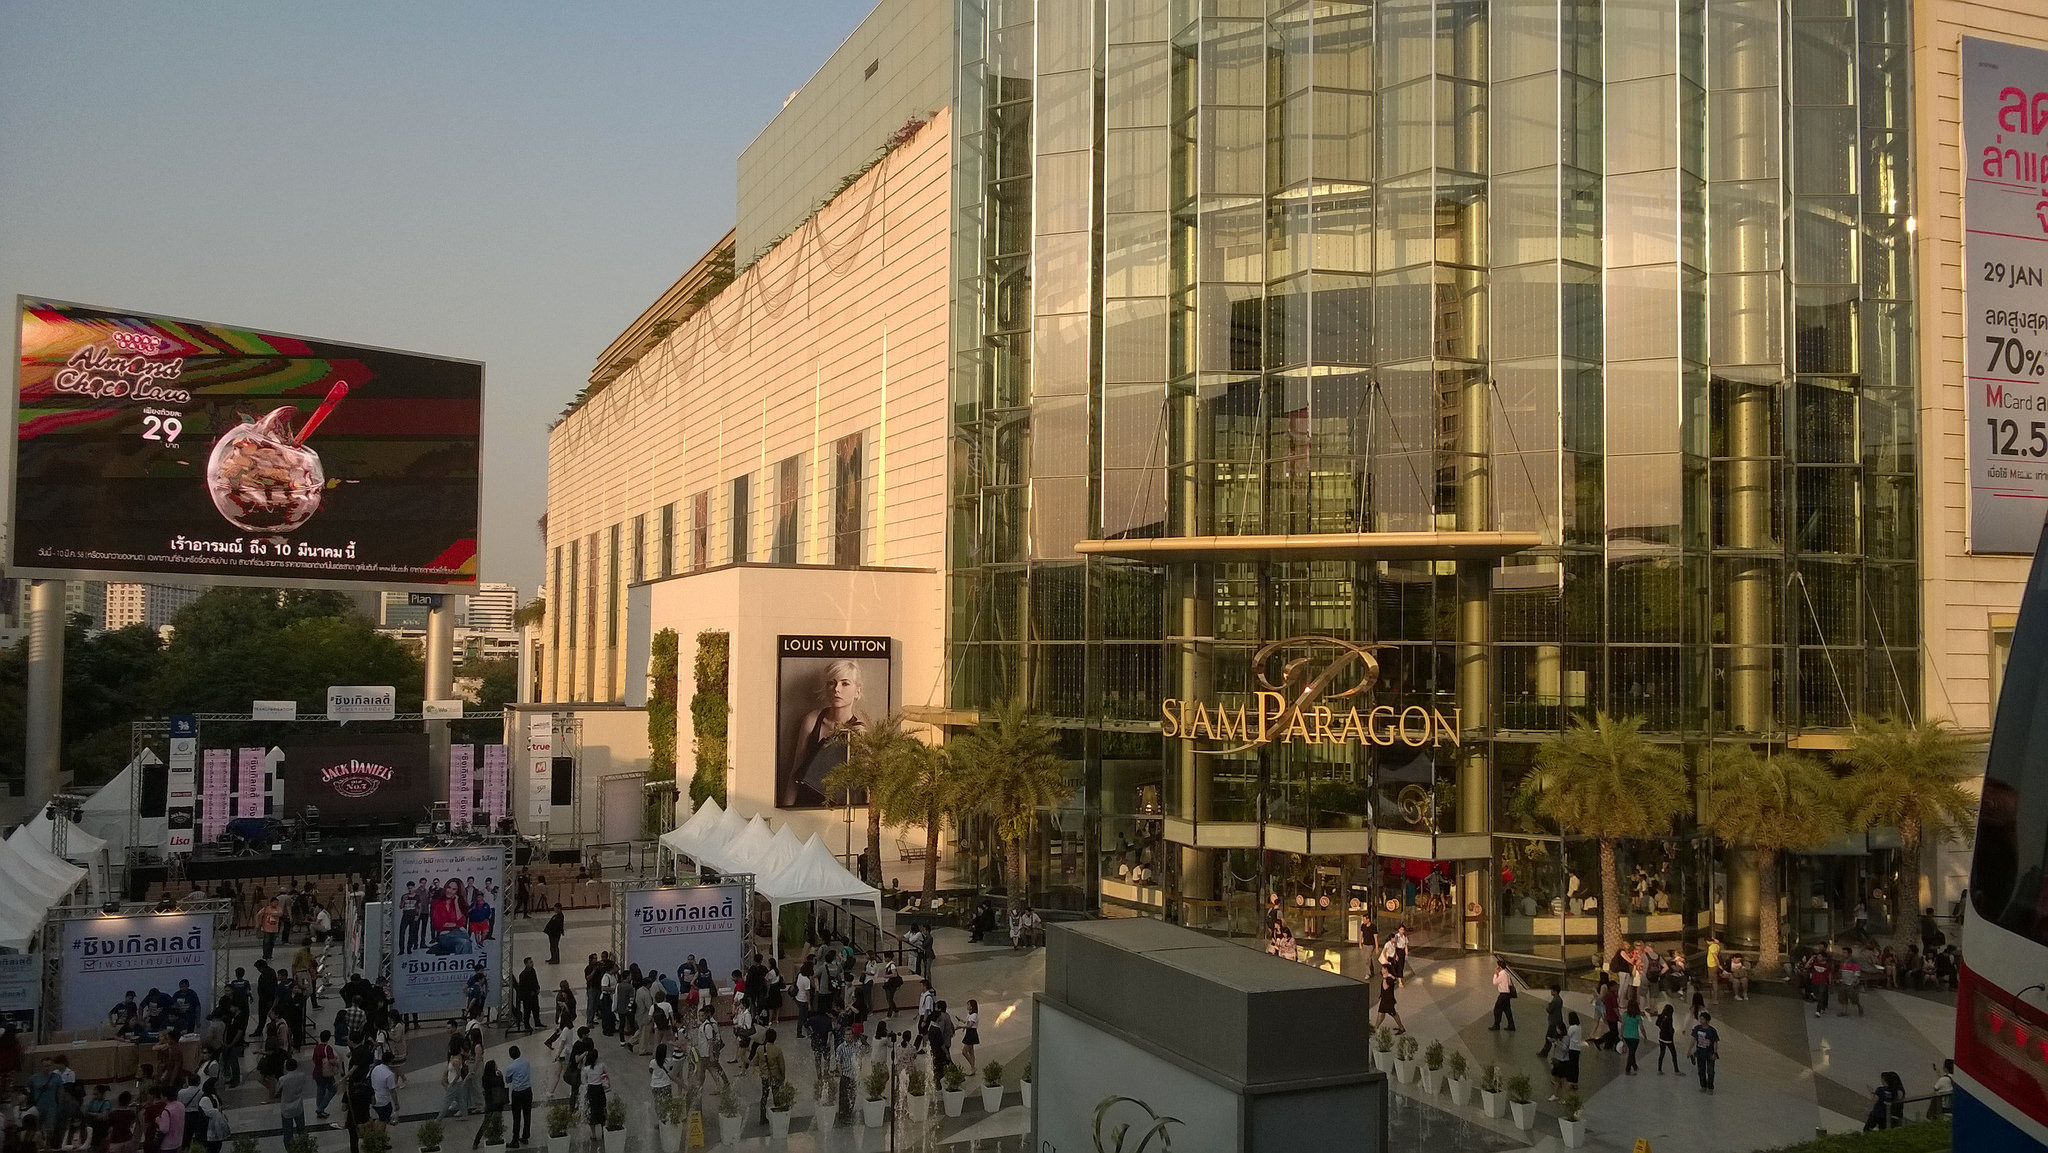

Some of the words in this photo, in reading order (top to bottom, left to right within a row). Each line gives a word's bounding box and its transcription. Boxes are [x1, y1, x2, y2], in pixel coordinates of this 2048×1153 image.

[1984, 261, 2006, 282] 29
[2008, 264, 2043, 289] JAN
[1985, 309, 2048, 336] ลดสูงสุด
[115, 333, 161, 346] KREAM
[119, 341, 157, 351] BALL
[68, 345, 184, 379] Almond
[55, 368, 130, 399] Choco
[131, 375, 191, 403] Lava
[142, 415, 183, 443] 29
[170, 534, 244, 554] เร้าอารมณ์
[249, 539, 267, 556] ถึง
[274, 543, 292, 556] 10
[411, 594, 432, 605] Plan
[784, 639, 824, 651] LOUIS
[829, 640, 887, 652] VUITTON
[1161, 697, 1251, 743] SIAM
[1253, 691, 1463, 749] PARAGON
[532, 743, 551, 751] true
[321, 763, 350, 782] JACK
[350, 759, 395, 781] DANIEL'S
[169, 836, 191, 846] Lisa
[634, 896, 733, 923] #ซิงเกิลเลดี้
[72, 926, 201, 956] #ซิงเกิลเลดี้
